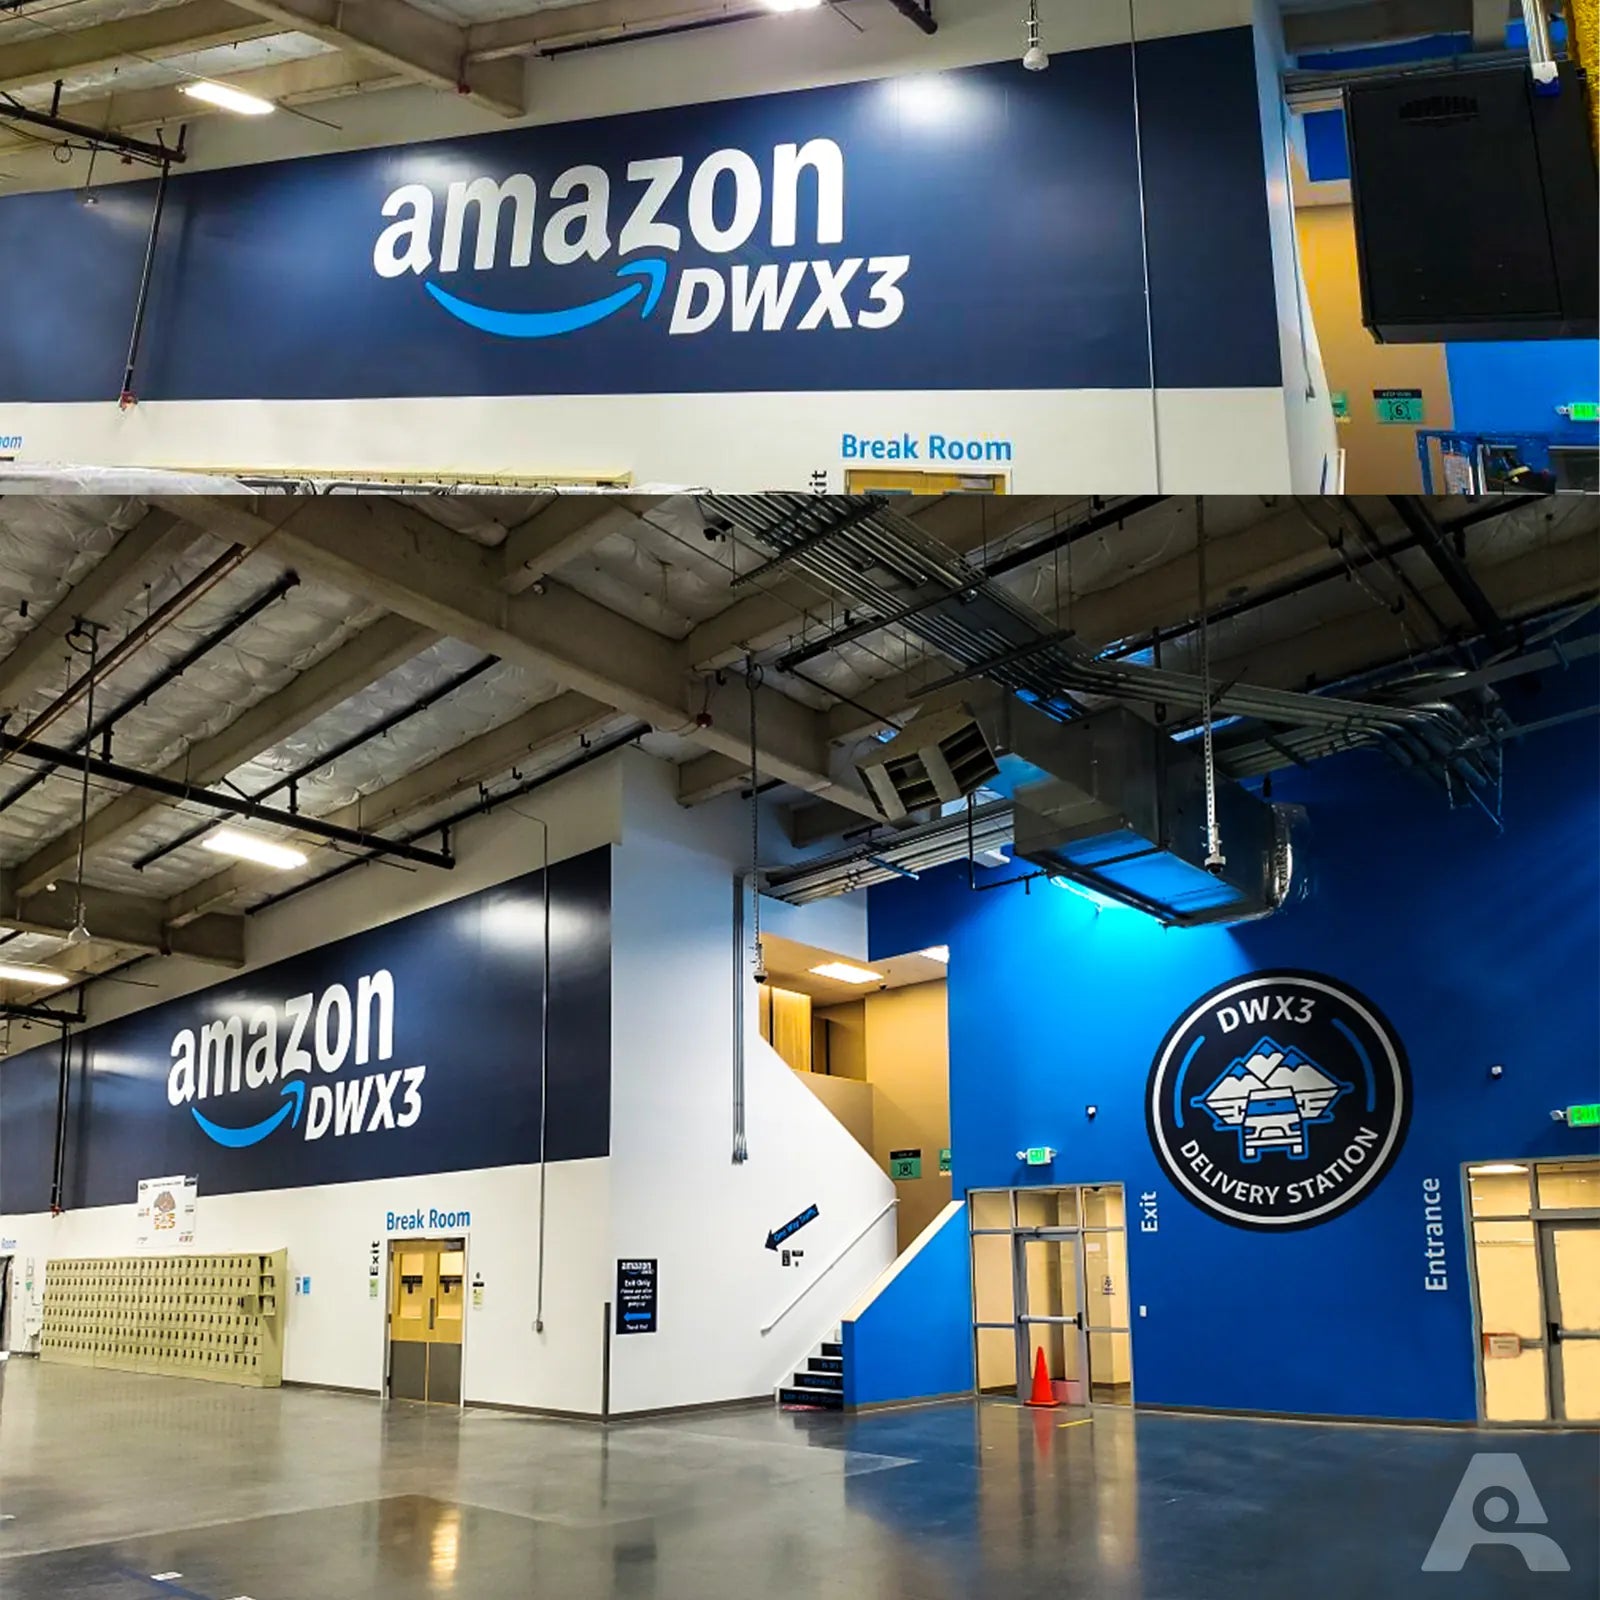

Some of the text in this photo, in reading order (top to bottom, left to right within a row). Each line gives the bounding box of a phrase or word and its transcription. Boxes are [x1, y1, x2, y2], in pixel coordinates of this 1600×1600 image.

[373, 138, 845, 278] amazon
[668, 255, 911, 335] DWX3
[0, 436, 22, 448] om
[842, 433, 1012, 460] Break Room
[167, 969, 395, 1106] amazon
[1216, 996, 1316, 1034] DWX3
[304, 1066, 426, 1141] DWX3
[1180, 1127, 1379, 1205] DELIVERY STATION
[386, 1208, 471, 1231] Break Room
[1139, 1190, 1159, 1233] Exit
[1424, 1177, 1448, 1292] Entrance
[369, 1240, 381, 1277] Exit
